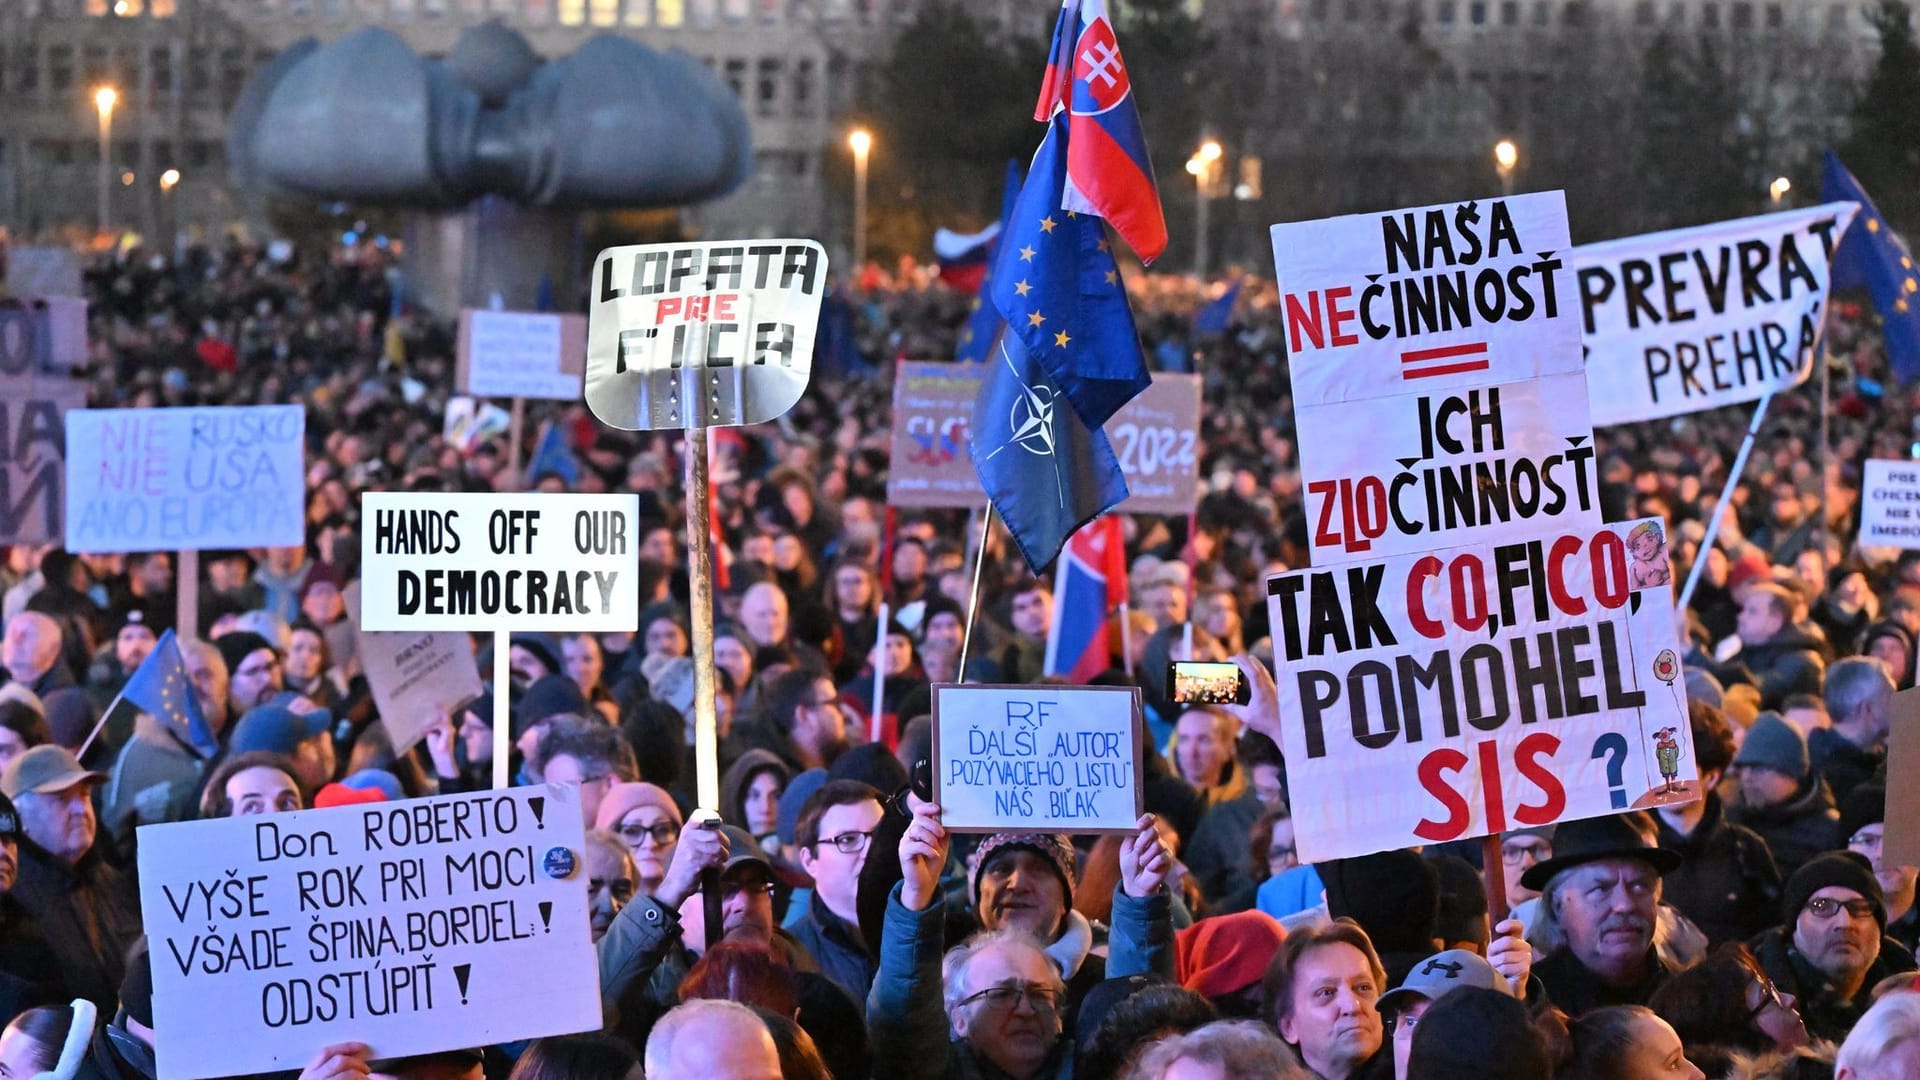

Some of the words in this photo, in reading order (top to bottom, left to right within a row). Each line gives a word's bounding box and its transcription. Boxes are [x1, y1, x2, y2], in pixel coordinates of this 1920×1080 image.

[1382, 200, 1523, 274] NAŠA
[601, 245, 819, 303] LOPATA
[1285, 251, 1562, 352] NEČINNOSŤ
[1577, 215, 1837, 334] PREVRAT
[616, 322, 795, 374] FICA
[101, 415, 169, 452] NIE
[190, 410, 299, 450] RUSKO
[1417, 388, 1504, 459] ICH
[98, 454, 169, 496] NIE
[184, 450, 279, 492] USA
[1308, 436, 1594, 553] ZLOČINNOSŤ
[76, 497, 149, 541] ANO
[376, 509, 461, 555] HANDS
[489, 509, 540, 555] OFF
[574, 510, 626, 555] OUR
[398, 569, 618, 615] DEMOCRACY
[1267, 564, 1398, 661] TAK
[1006, 701, 1058, 727] RF
[1297, 620, 1646, 759] POMOHEL
[968, 724, 1039, 757] ĎALŠÍ
[995, 786, 1034, 817] NÁŠ
[1413, 732, 1566, 842] SIS
[256, 822, 338, 861] Don
[364, 797, 517, 851] ROBERTO
[162, 869, 270, 923] VYŠE
[297, 864, 368, 912] ROK
[380, 858, 427, 902] PRI
[446, 845, 535, 895] MOCI
[167, 925, 293, 977] VŠADE
[262, 954, 437, 1028] ODSTÚPIŤ
